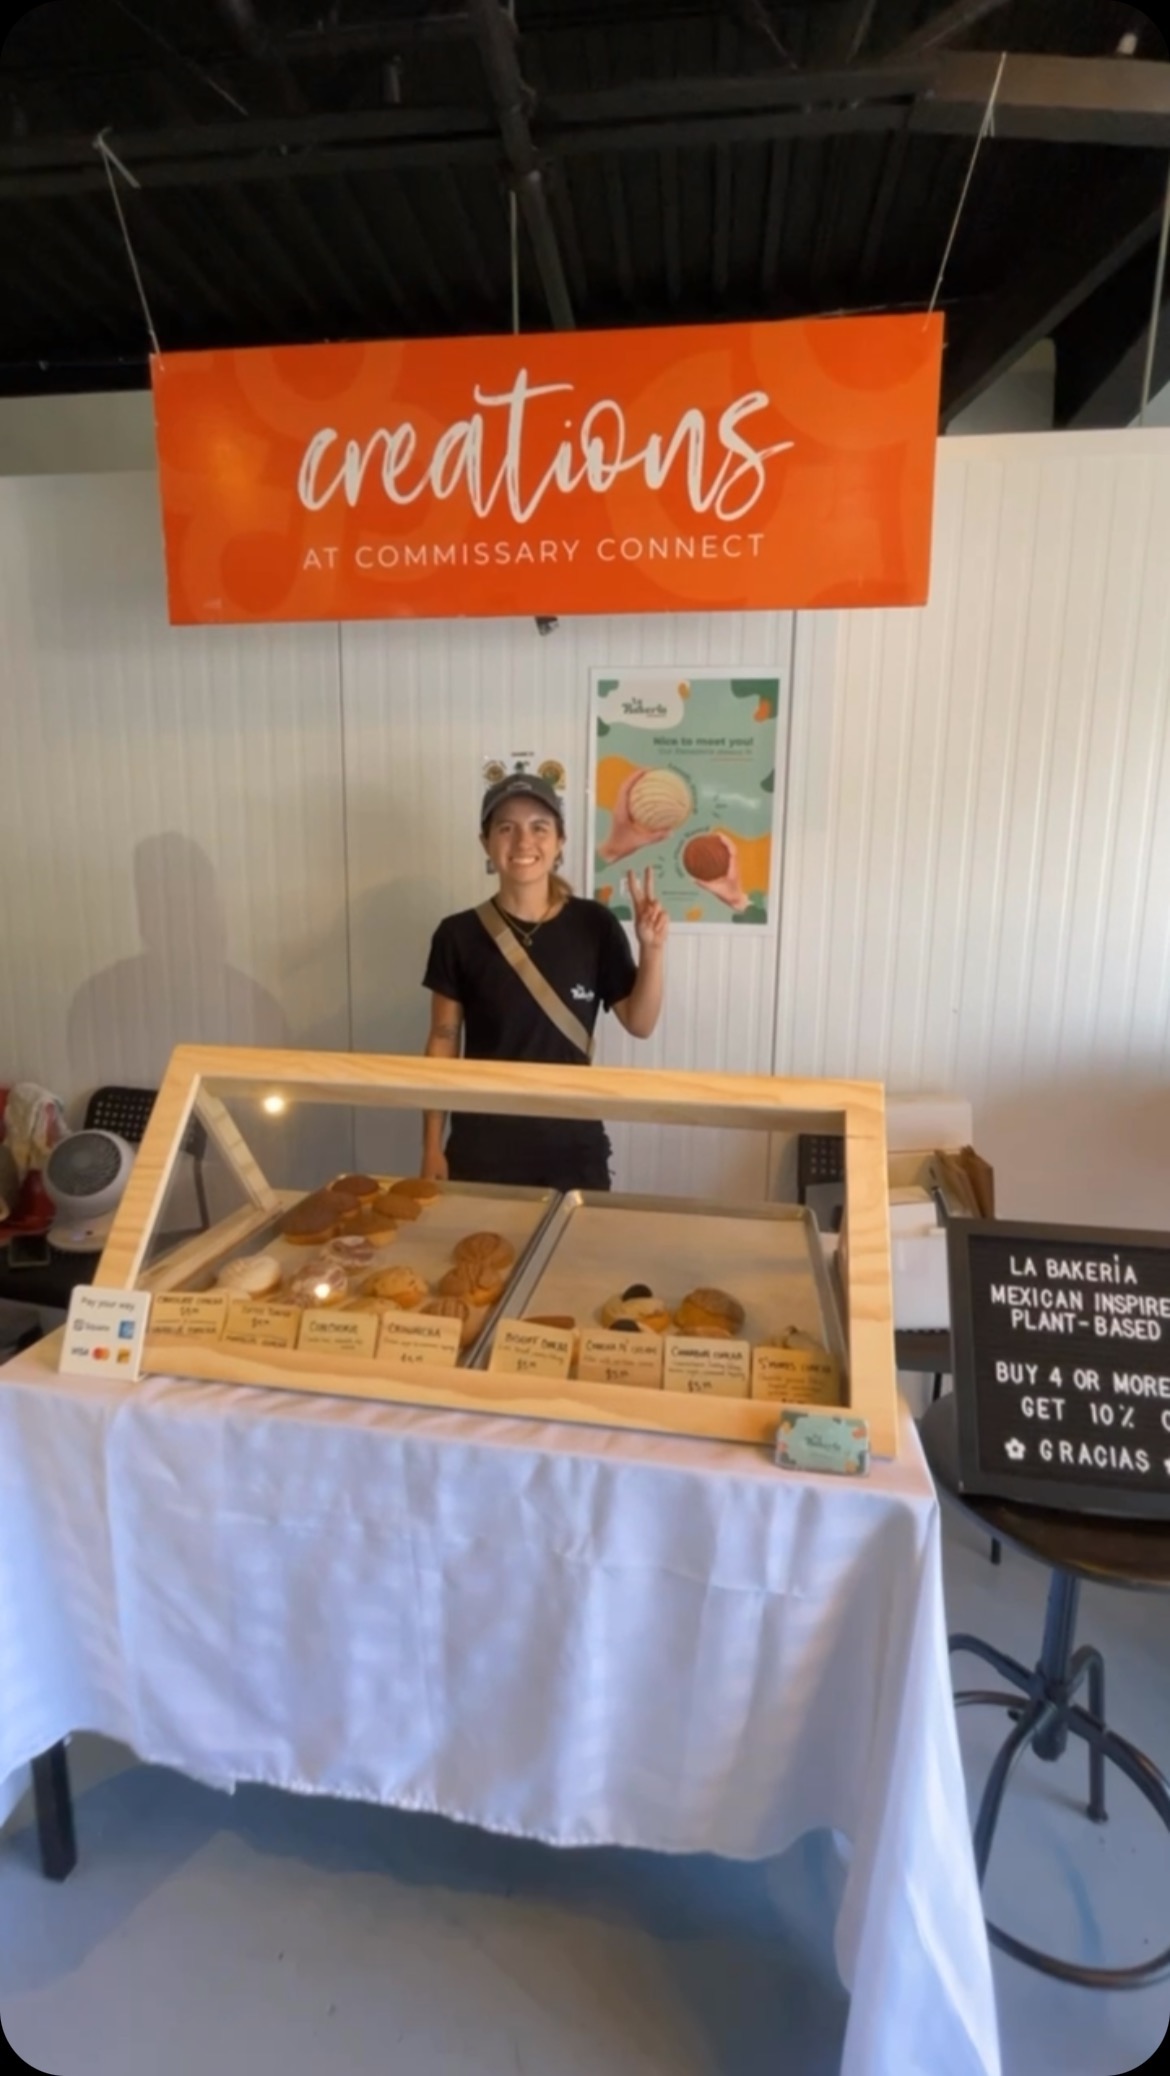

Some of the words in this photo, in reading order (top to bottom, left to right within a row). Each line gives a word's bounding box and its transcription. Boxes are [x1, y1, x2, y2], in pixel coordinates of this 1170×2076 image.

[297, 368, 795, 524] creations
[303, 547, 339, 570] AT
[355, 540, 580, 569] COMMISSARY
[597, 533, 764, 562] CONNECT
[653, 737, 678, 746] Nice
[681, 737, 693, 746] to
[696, 737, 725, 746] meet
[729, 737, 754, 749] you!
[1009, 1255, 1038, 1277] LA
[81, 1296, 96, 1309] Pay
[98, 1300, 117, 1310] your
[119, 1303, 135, 1313] way
[990, 1283, 1084, 1311] MEXICAN
[1010, 1307, 1162, 1342] PLANT-BASED
[995, 1360, 1039, 1386] BUY
[1048, 1366, 1063, 1388] 4
[1072, 1368, 1101, 1392] OR
[1112, 1371, 1170, 1399] MORE
[1020, 1395, 1066, 1421] GET
[1089, 1402, 1135, 1429] 10%
[1039, 1438, 1151, 1473] GRACIAS
